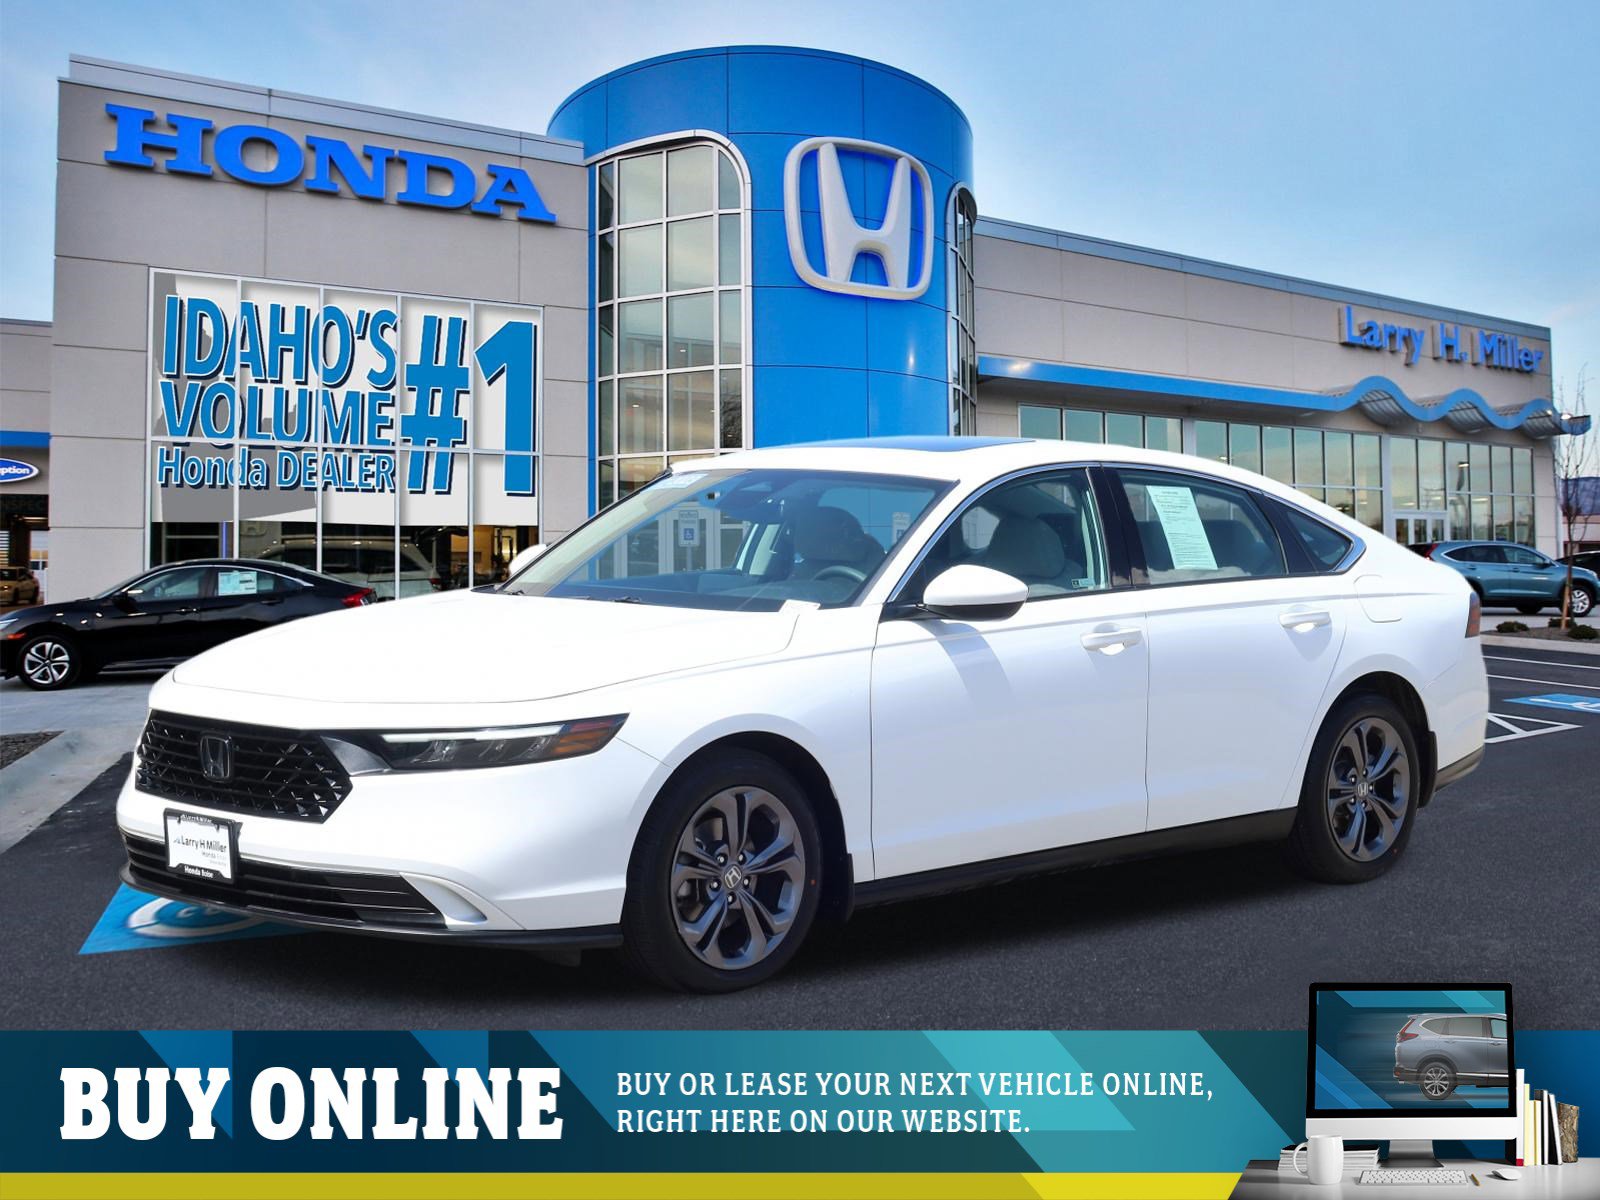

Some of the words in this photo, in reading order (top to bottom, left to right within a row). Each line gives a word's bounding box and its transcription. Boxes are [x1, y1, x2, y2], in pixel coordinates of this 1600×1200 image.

[105, 103, 557, 223] HONDA
[163, 295, 398, 389] IDAHO'S
[1339, 304, 1424, 366] Larry
[1433, 322, 1469, 363] H.
[1472, 330, 1544, 373] Miller
[160, 380, 397, 449] VOLUME
[401, 314, 536, 496] #1
[0, 465, 30, 476] ption
[157, 446, 270, 488] Honda
[276, 450, 397, 492] DEALER
[181, 835, 199, 850] Larry
[206, 840, 227, 853] Miller
[184, 865, 201, 876] Honda
